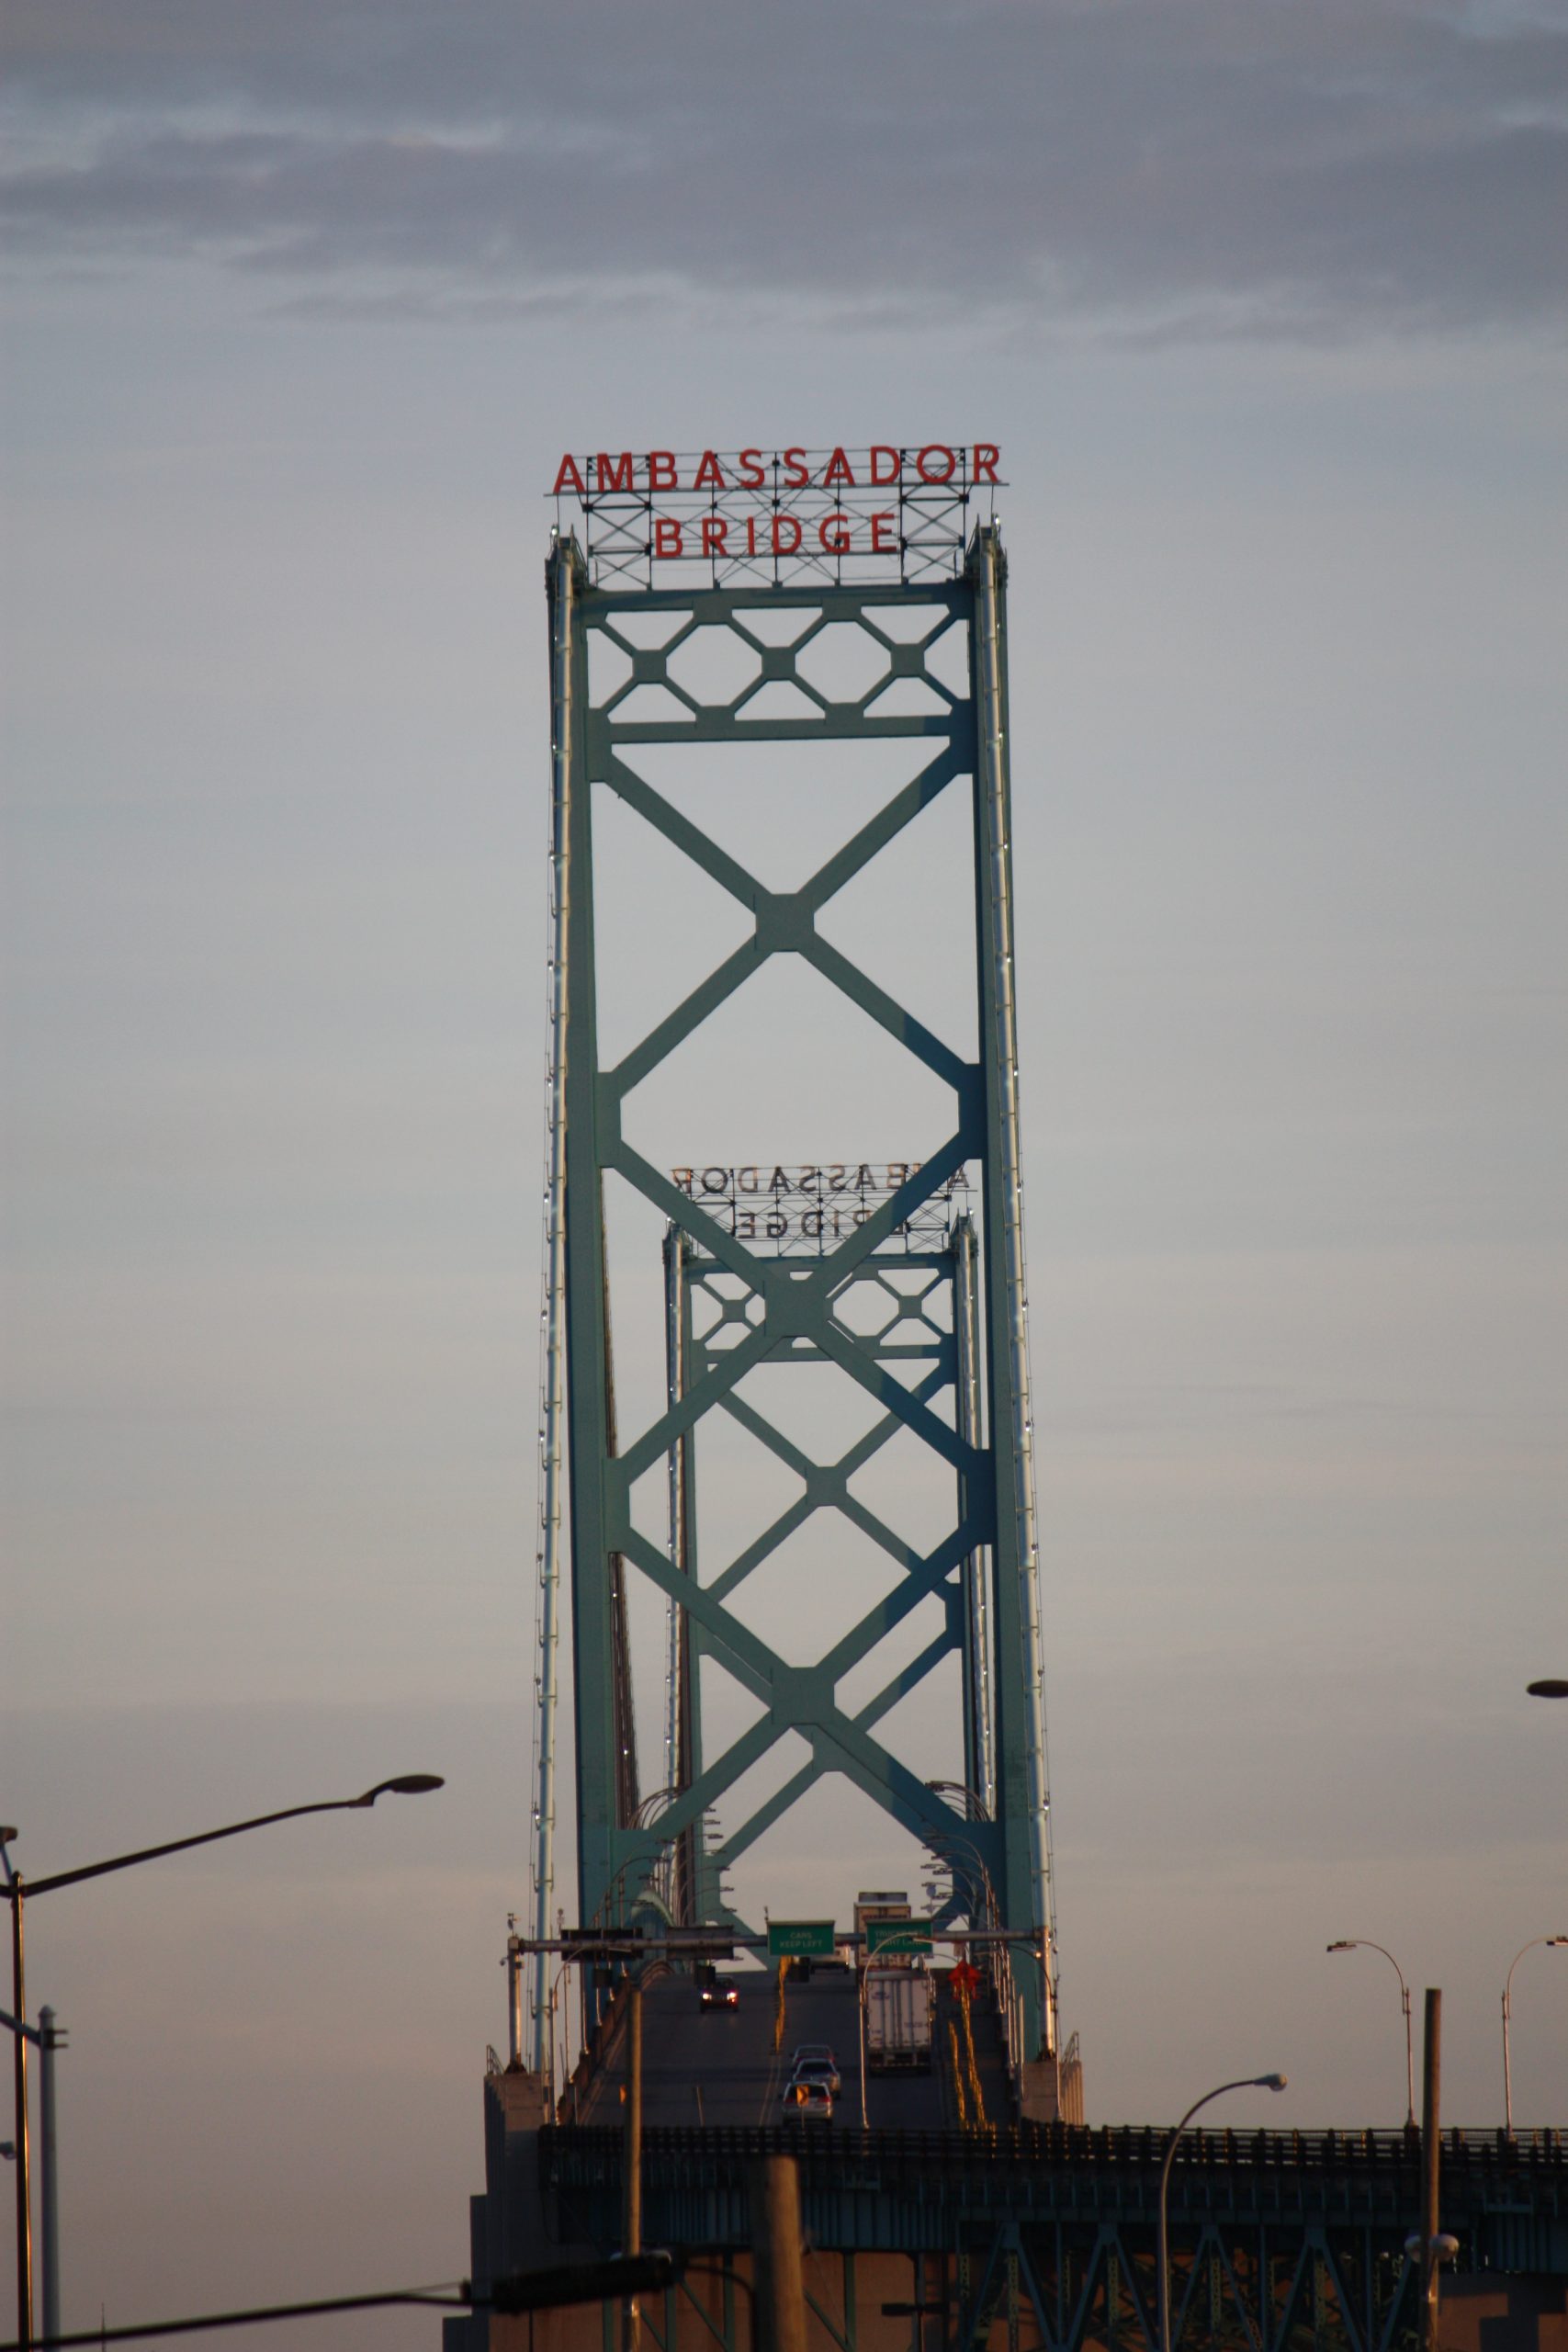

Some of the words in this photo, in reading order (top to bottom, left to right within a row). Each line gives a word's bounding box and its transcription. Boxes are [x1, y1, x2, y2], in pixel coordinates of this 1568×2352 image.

[553, 444, 1001, 493] AMBASSADOR
[655, 513, 897, 559] BRIDGE
[779, 1939, 801, 1948] KEEP
[802, 1939, 823, 1947] LEFT
[790, 1931, 813, 1939] CARS
